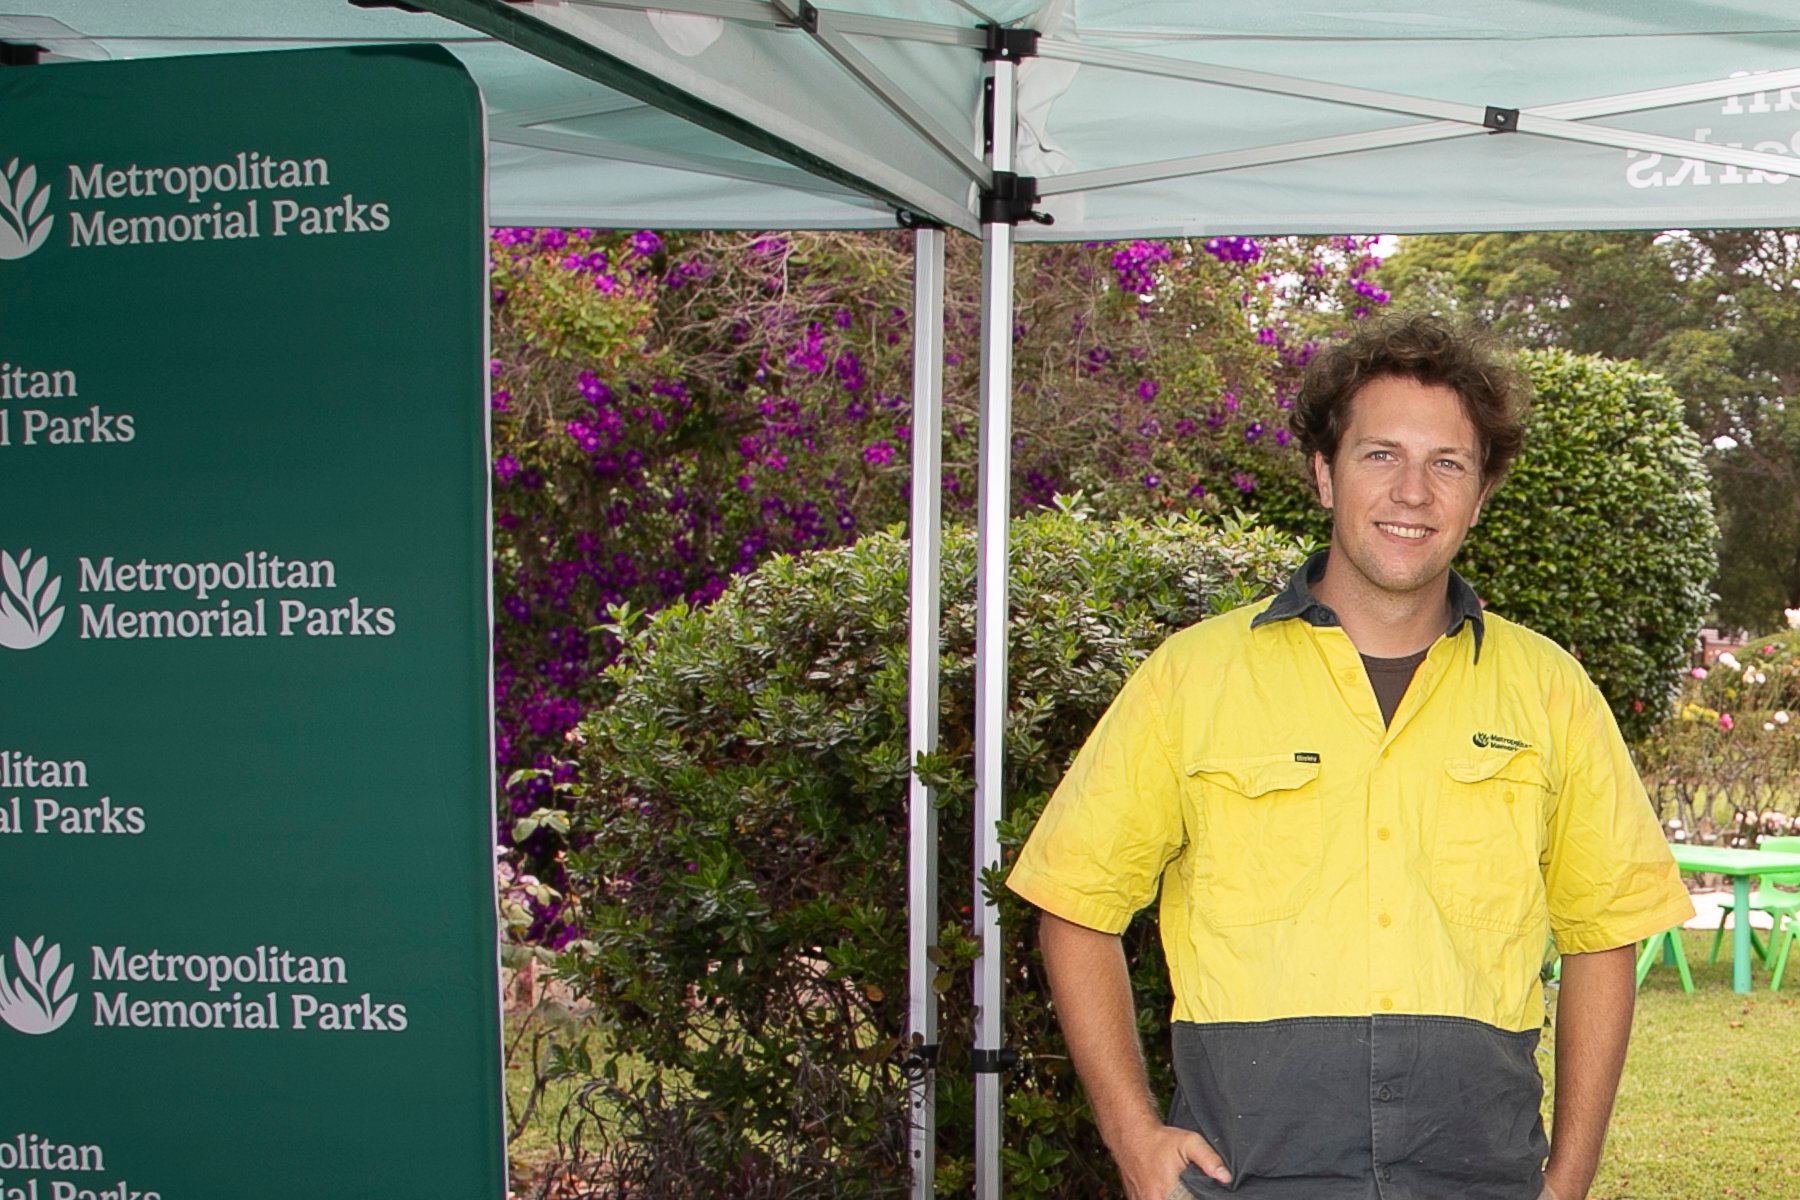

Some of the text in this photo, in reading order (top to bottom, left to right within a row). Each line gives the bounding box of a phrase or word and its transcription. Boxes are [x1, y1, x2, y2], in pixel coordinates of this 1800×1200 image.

[69, 152, 330, 203] Metropolitan
[70, 194, 389, 246] Memorial Parks
[24, 405, 135, 444] Parks
[80, 551, 336, 599] Metropolitan
[81, 597, 395, 638] Memorial Parks
[35, 797, 146, 833] Parks
[92, 946, 347, 992] Metropolitan
[94, 990, 407, 1031] Memorial Parks
